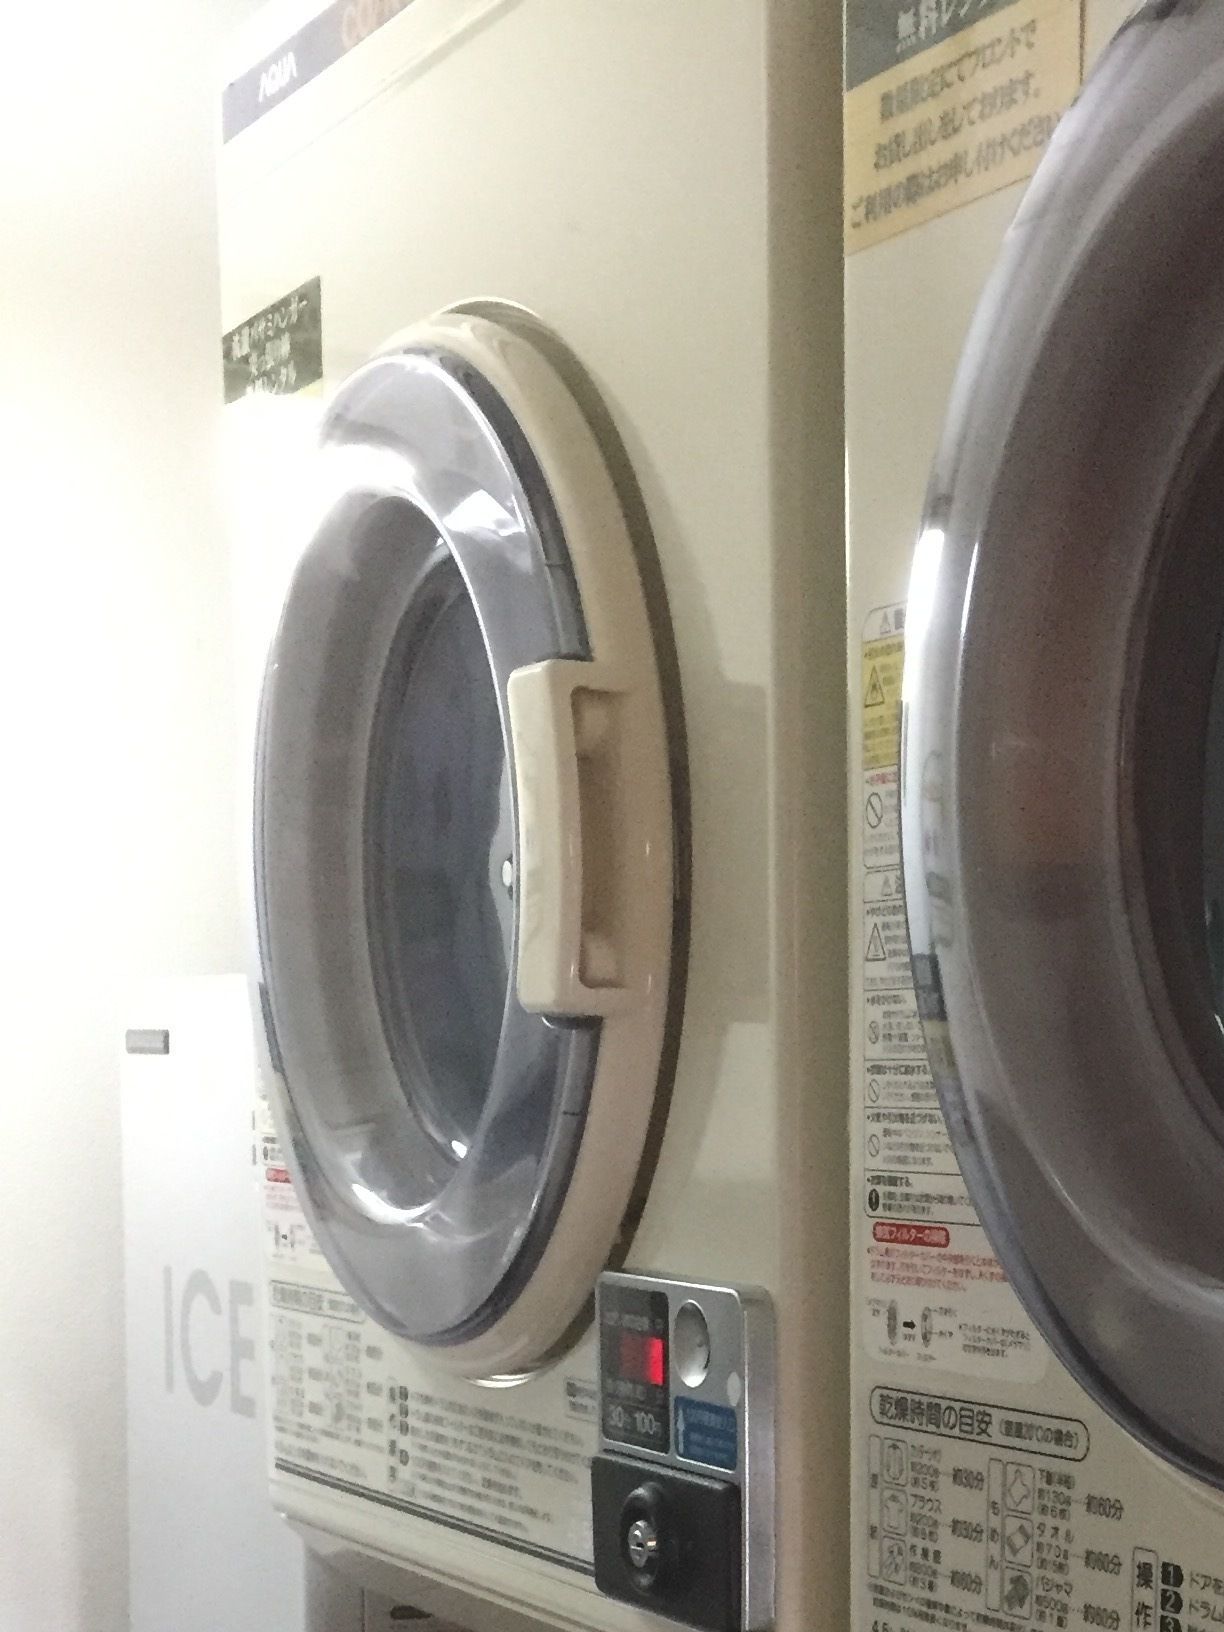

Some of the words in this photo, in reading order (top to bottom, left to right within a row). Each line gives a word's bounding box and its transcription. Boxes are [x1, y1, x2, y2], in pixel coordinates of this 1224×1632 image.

[163, 1264, 257, 1418] ICE
[878, 1393, 993, 1438] 乾燥時間の目安
